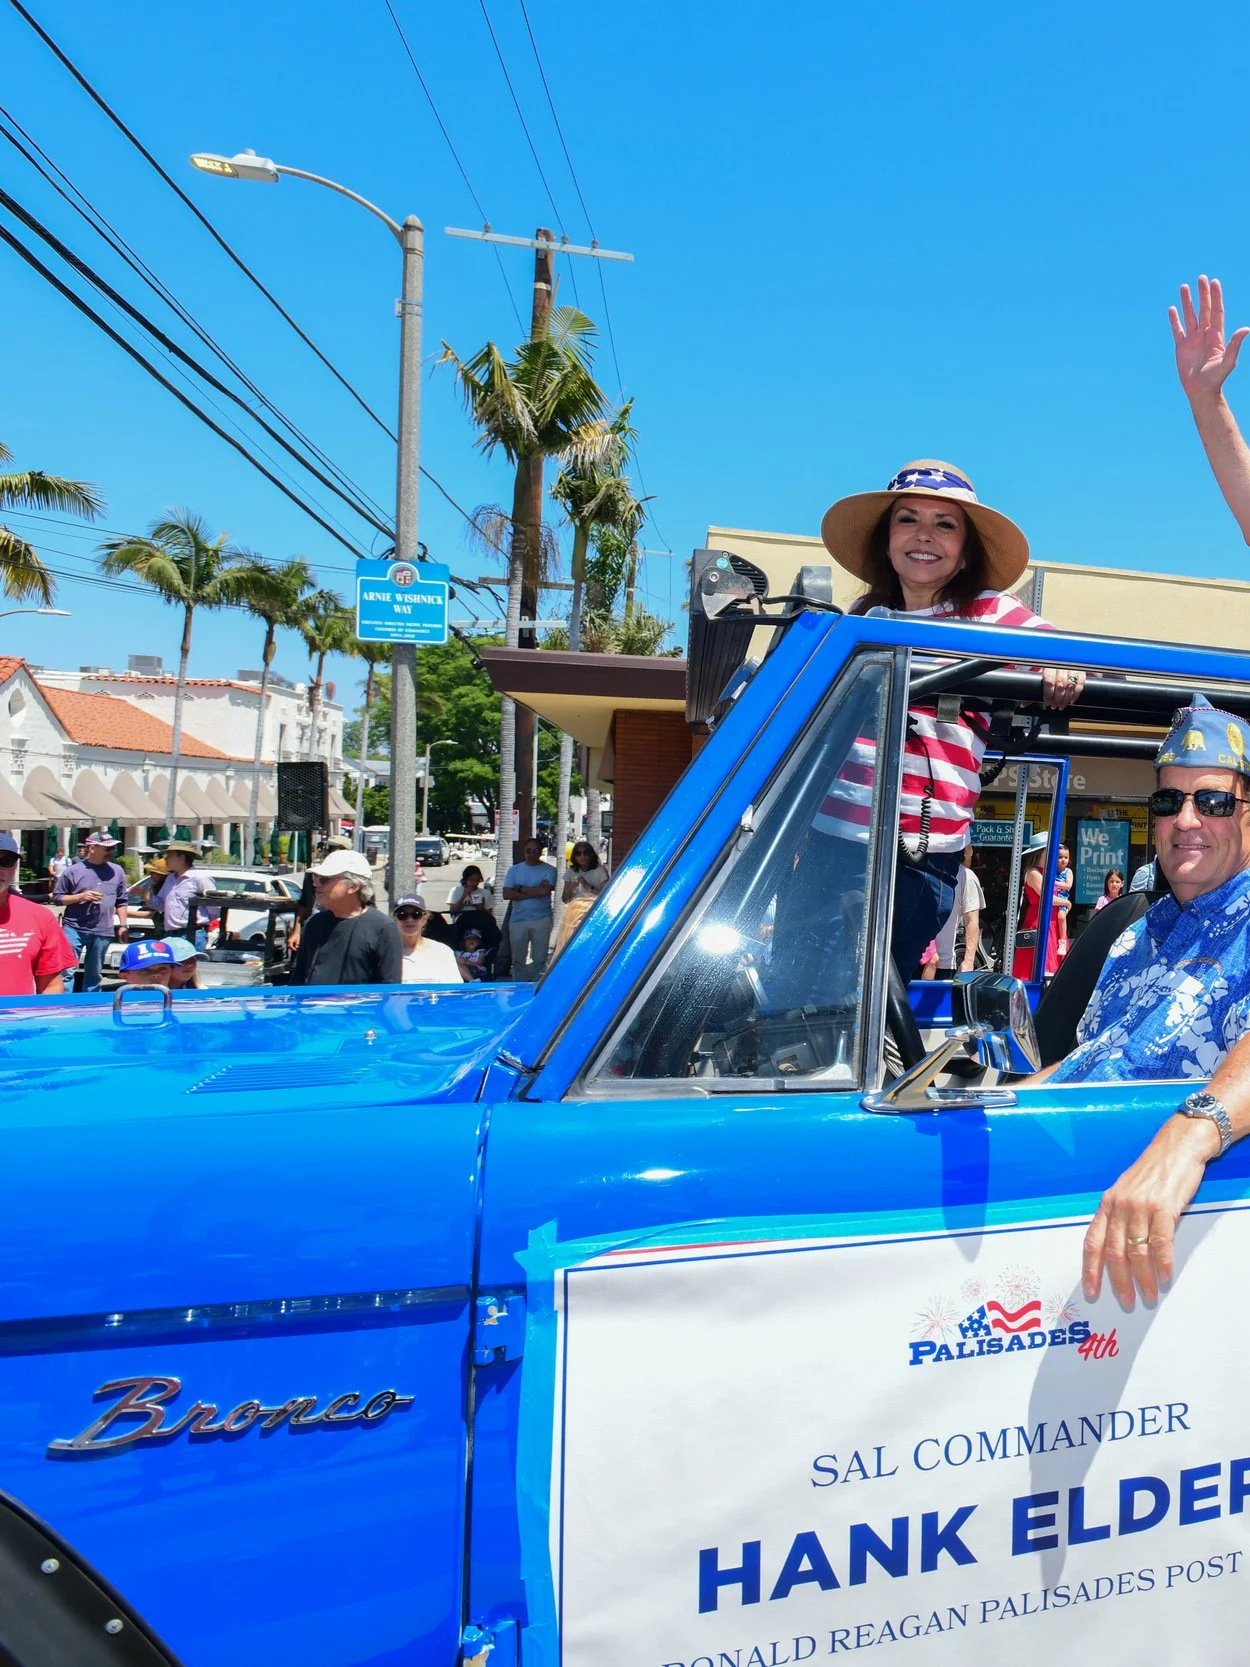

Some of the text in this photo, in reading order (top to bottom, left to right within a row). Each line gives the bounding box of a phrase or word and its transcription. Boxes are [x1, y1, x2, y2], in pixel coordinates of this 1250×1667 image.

[362, 592, 444, 605] ARNIE WISHNICK
[393, 604, 413, 614] WAY
[976, 824, 1014, 833] Pack & Sh
[979, 833, 1014, 842] Guarante
[1080, 828, 1110, 846] We
[1080, 847, 1124, 865] Print
[908, 1321, 1120, 1366] PALISADES 4th
[47, 1376, 415, 1450] Bronco
[810, 1402, 1192, 1489] SAL COMMANDER
[698, 1504, 979, 1615] HANK
[662, 1635, 817, 1667] NALD
[828, 1604, 969, 1655] REAGAN
[979, 1567, 1156, 1625] PALISADES
[1165, 1551, 1244, 1591] POST
